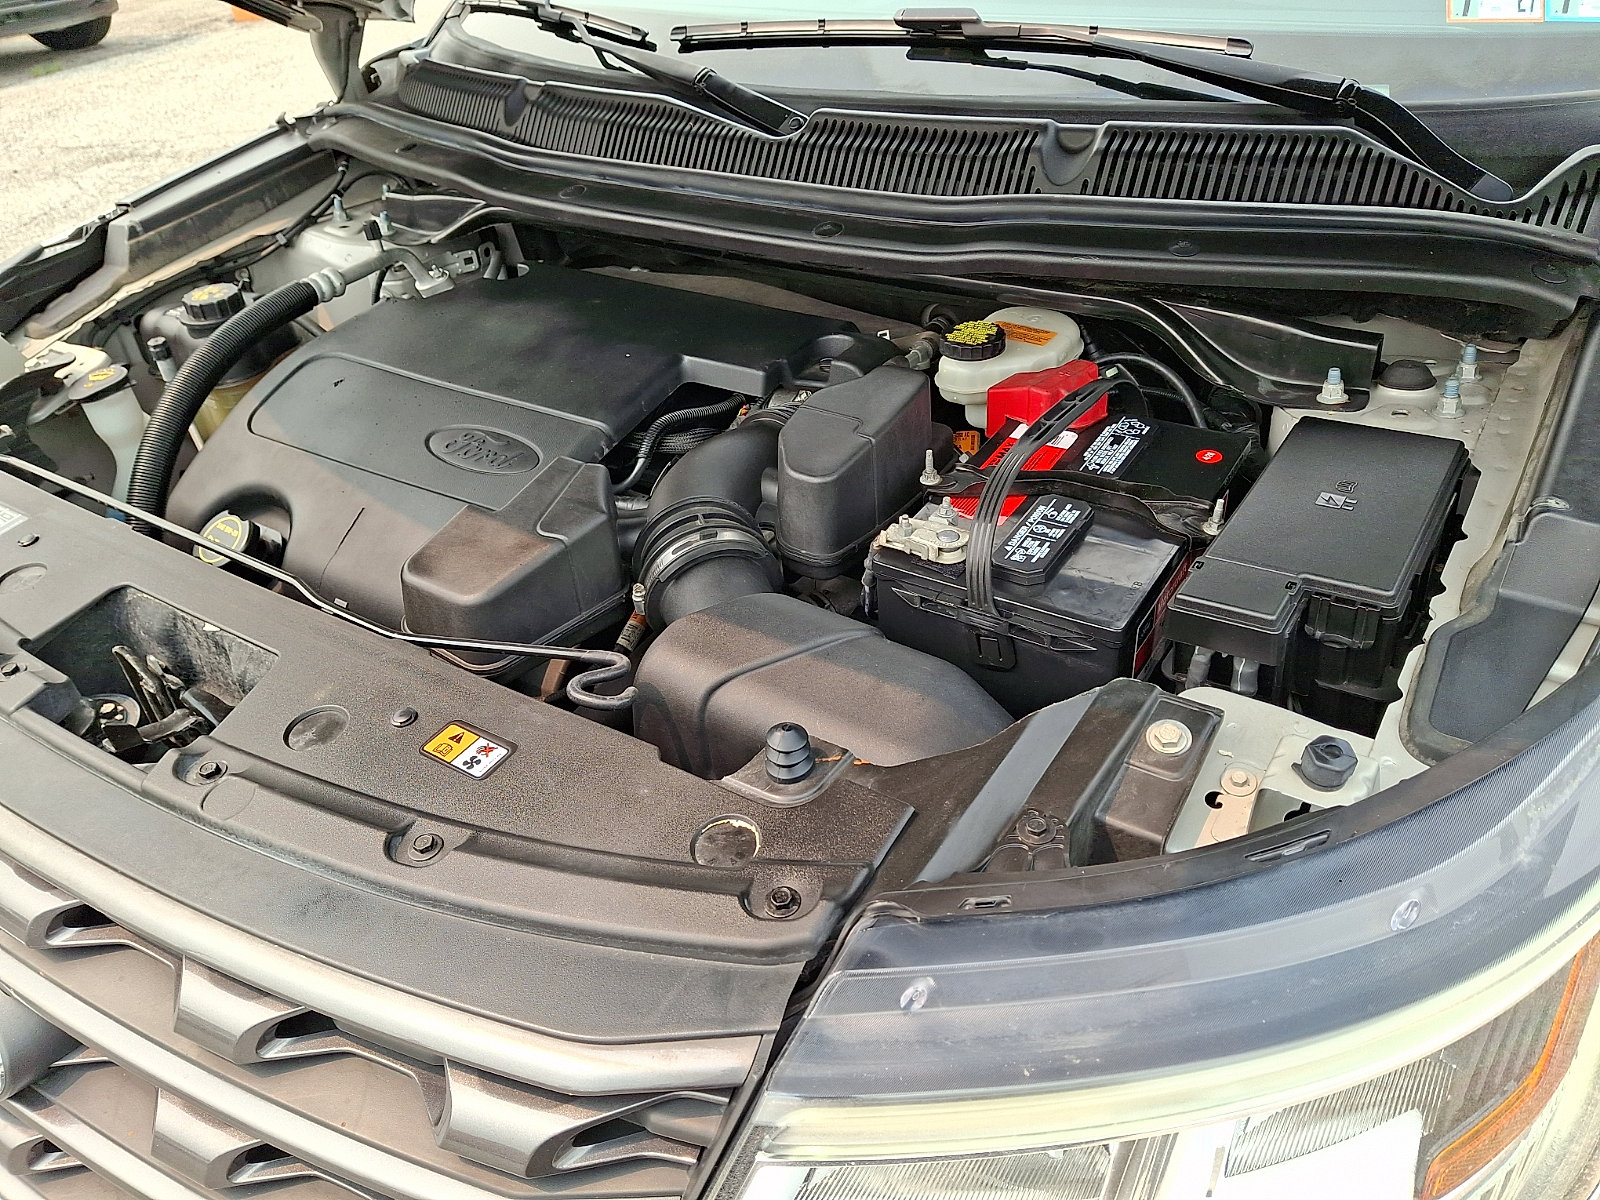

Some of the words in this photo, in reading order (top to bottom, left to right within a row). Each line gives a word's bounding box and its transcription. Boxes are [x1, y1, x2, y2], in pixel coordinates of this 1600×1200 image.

[442, 431, 524, 469] Ford
[1007, 525, 1028, 546] DANGER
[1028, 505, 1048, 523] POISON
